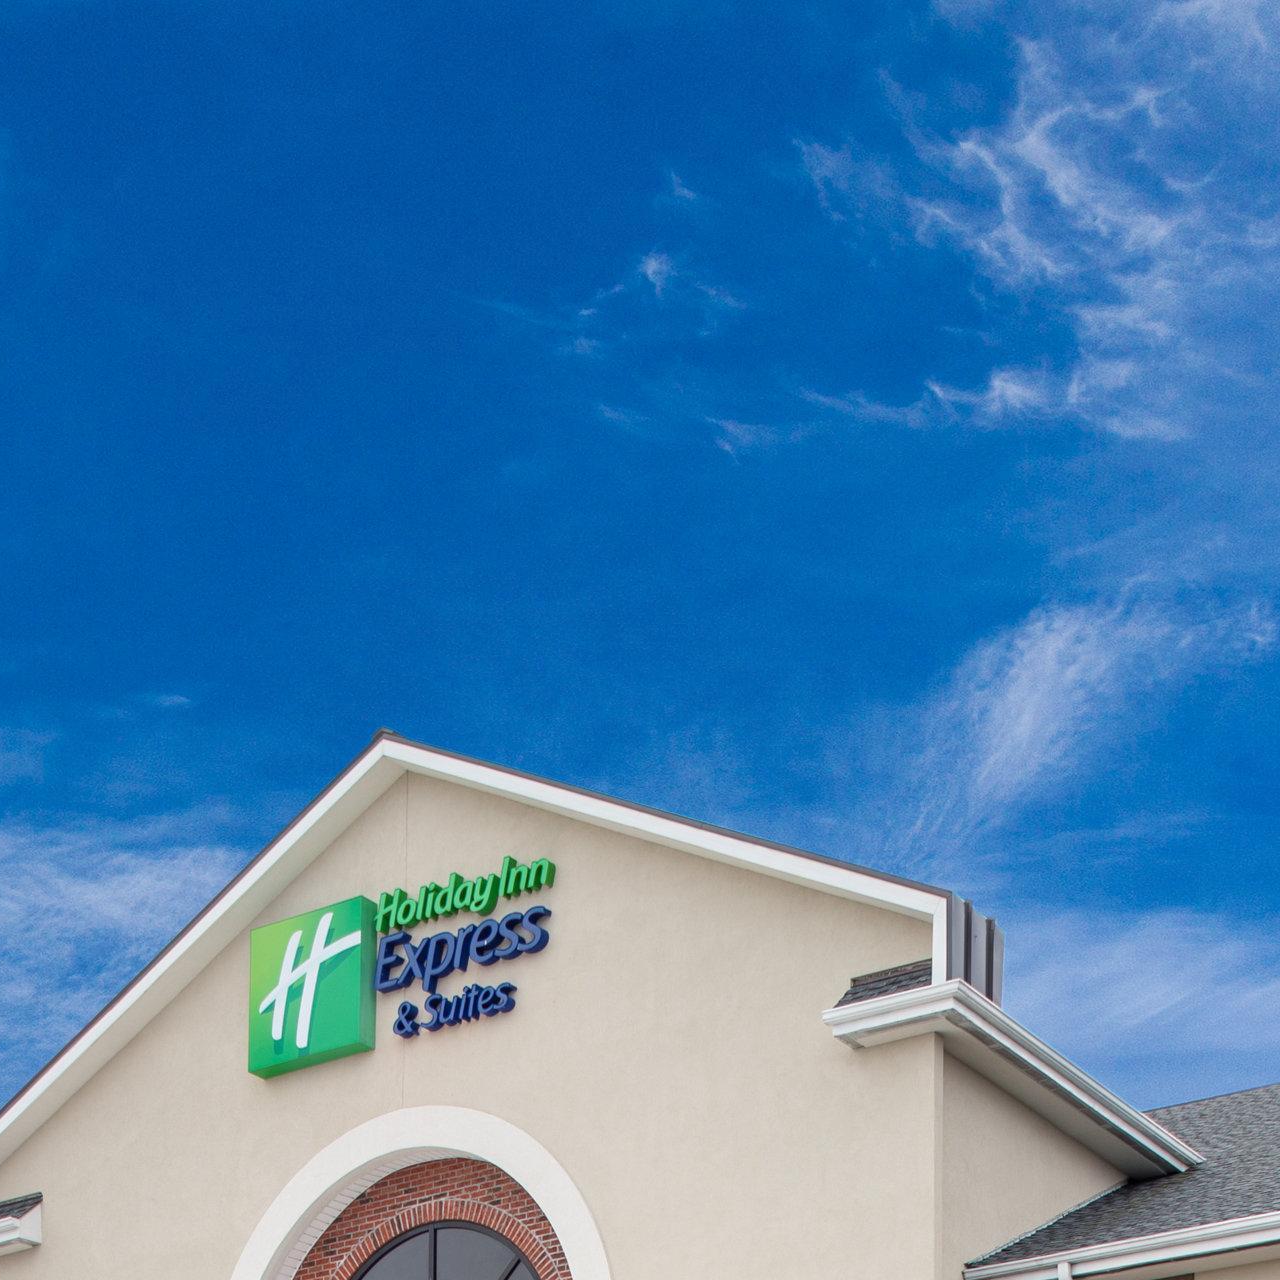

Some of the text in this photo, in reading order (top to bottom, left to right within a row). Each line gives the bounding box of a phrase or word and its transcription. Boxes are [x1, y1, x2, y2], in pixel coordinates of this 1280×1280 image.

[374, 855, 556, 933] Holiday Inn
[374, 905, 552, 993] Express
[393, 982, 517, 1039] & Suites
